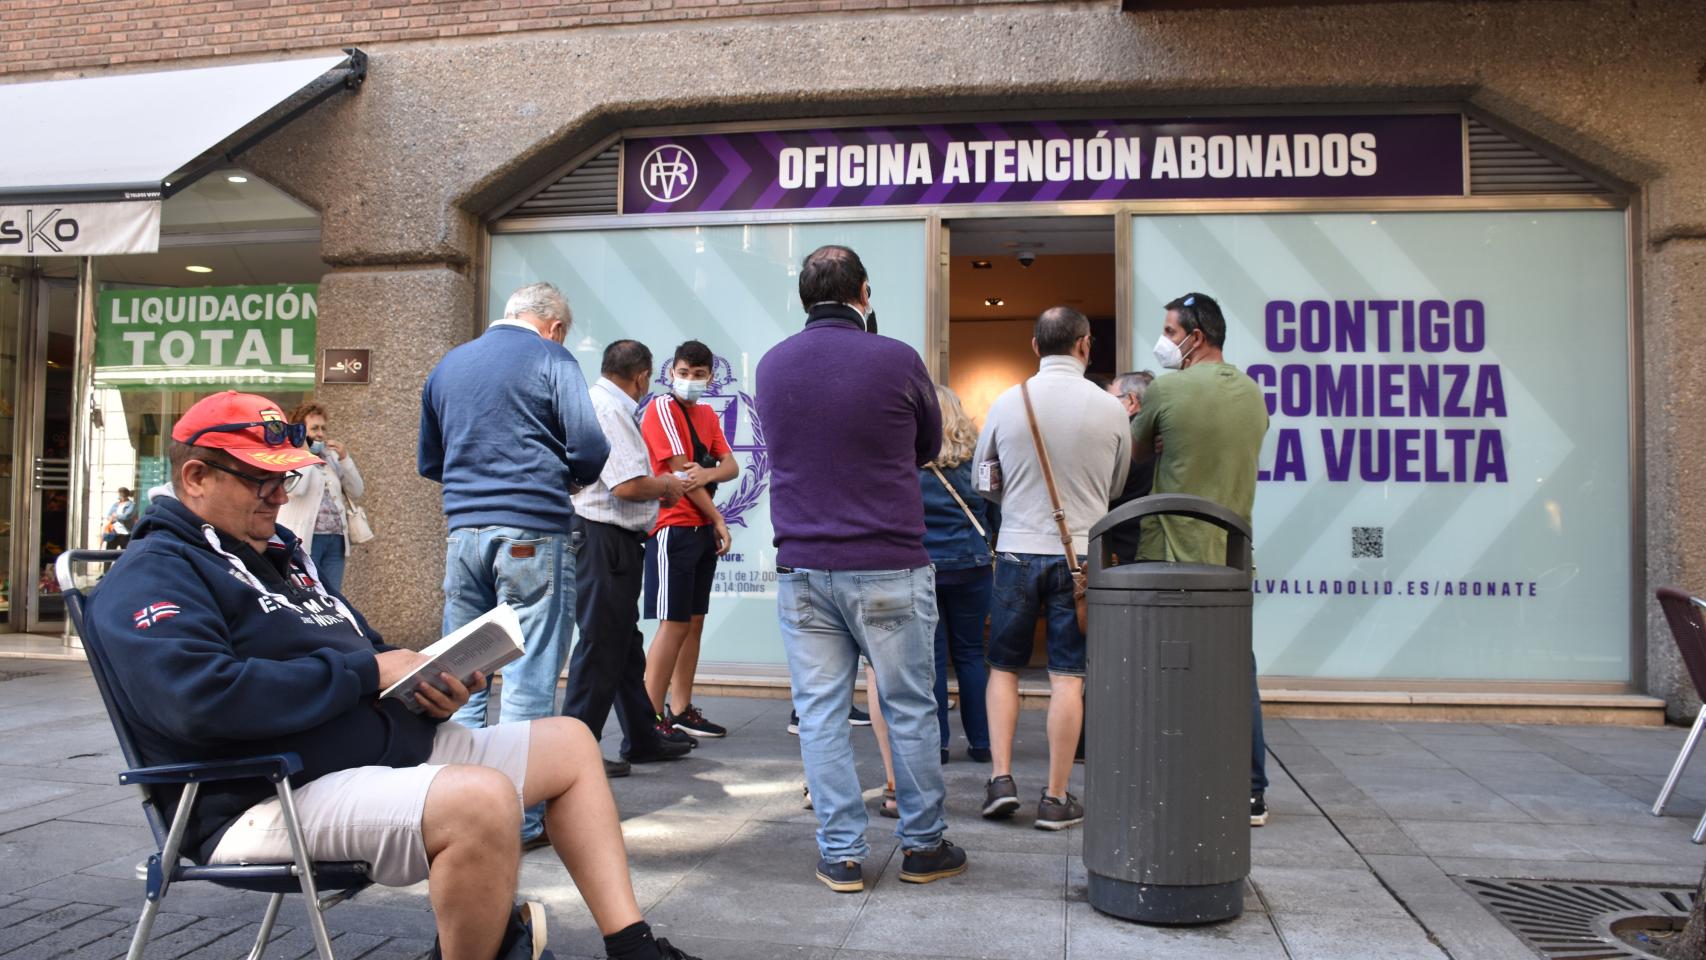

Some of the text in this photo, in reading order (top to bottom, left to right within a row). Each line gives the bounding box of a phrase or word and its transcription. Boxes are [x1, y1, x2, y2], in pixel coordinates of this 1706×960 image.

[778, 129, 1377, 189] OFICINA ATENCIÓN ABONADOS
[111, 286, 318, 325] LIQUIDACIÓN
[1264, 299, 1486, 353] CONTIGO
[122, 328, 310, 366] TOTAL
[1246, 363, 1509, 418] COMIENZA
[1320, 428, 1509, 483] VUELTA
